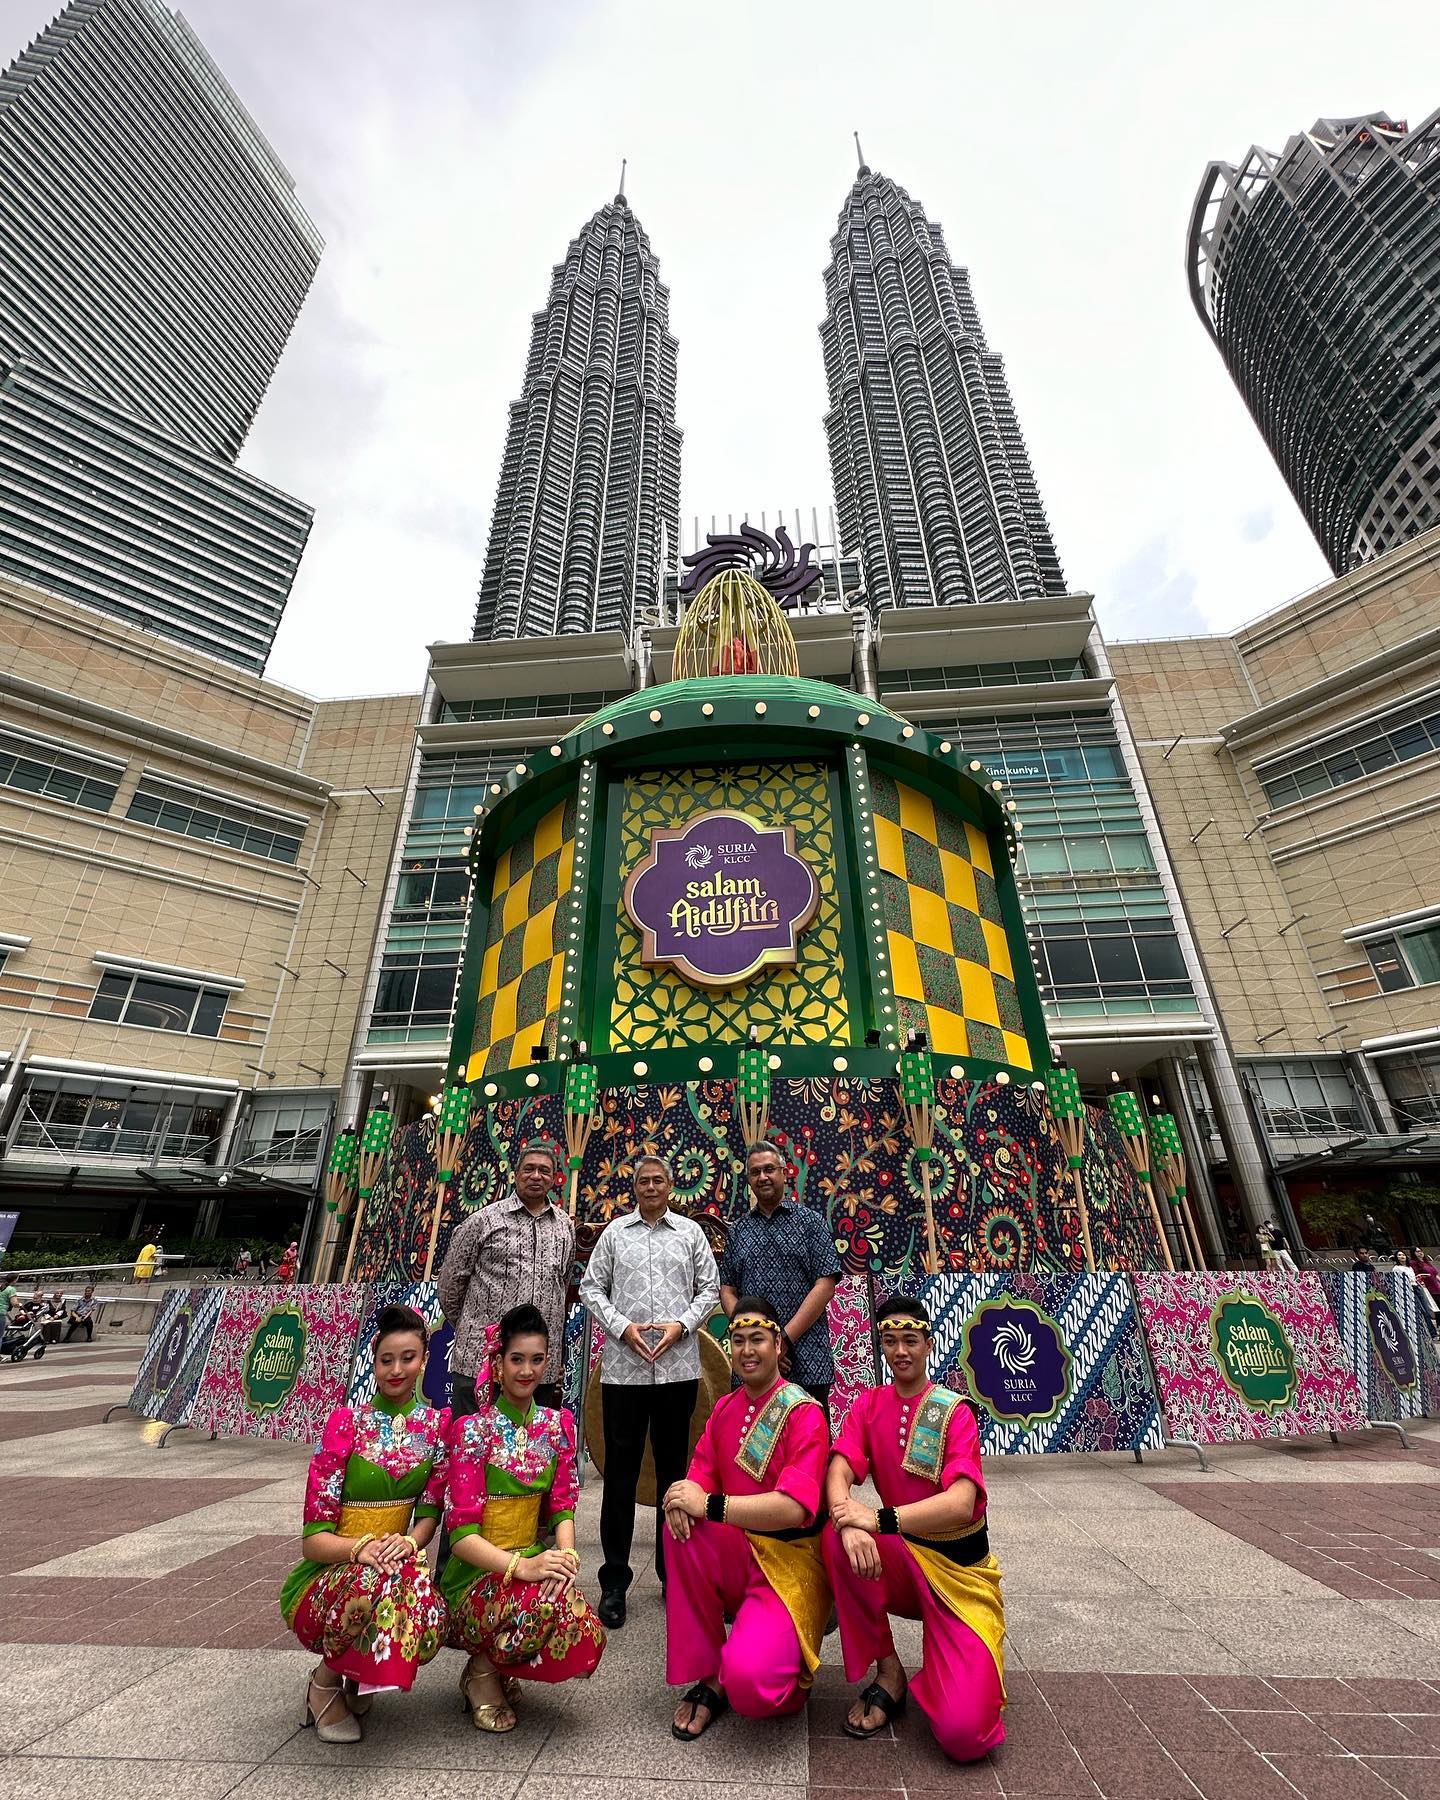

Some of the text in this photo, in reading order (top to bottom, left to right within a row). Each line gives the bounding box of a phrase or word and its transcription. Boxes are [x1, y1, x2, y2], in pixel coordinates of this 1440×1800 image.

[717, 843, 757, 854] SURIA
[724, 855, 751, 864] KLCC
[686, 870, 767, 899] salam
[666, 897, 780, 938] Aidilfitri
[263, 1326, 295, 1353] salam
[1229, 1317, 1274, 1345] salam
[251, 1348, 296, 1381] Aidilfitri
[1225, 1340, 1288, 1377] Aidilfitri
[1004, 1379, 1037, 1389] SURIA
[1011, 1393, 1033, 1402] KLCC
